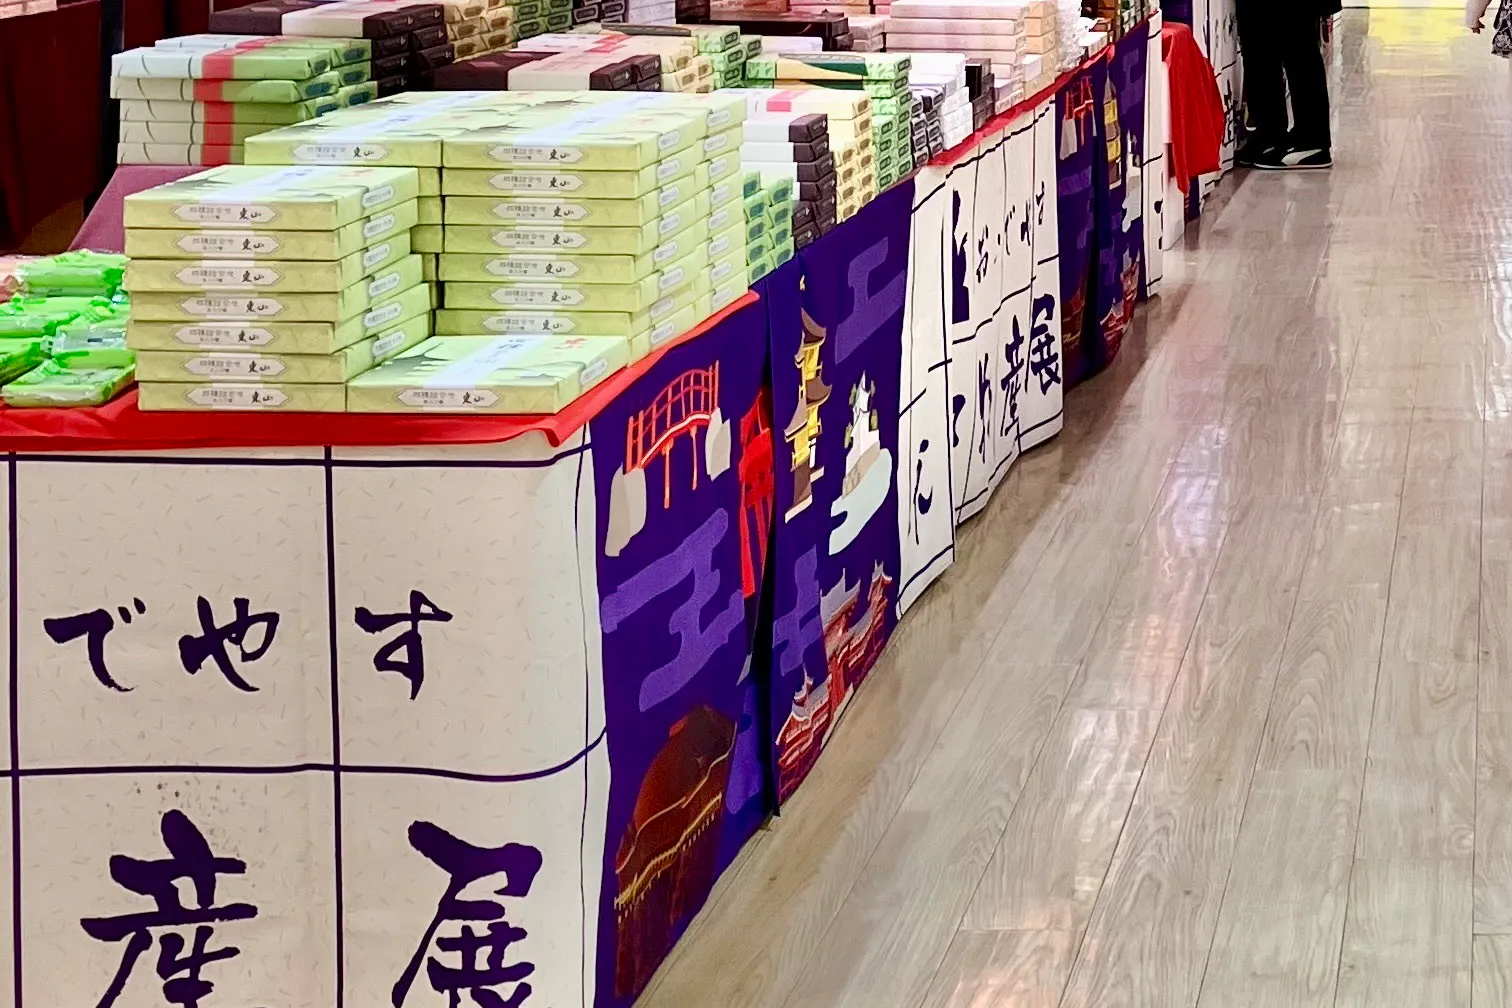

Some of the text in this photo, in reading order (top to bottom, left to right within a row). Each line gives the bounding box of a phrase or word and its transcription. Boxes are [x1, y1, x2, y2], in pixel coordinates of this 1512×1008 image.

[44, 590, 453, 700] でやす
[80, 809, 544, 1008] 産展
